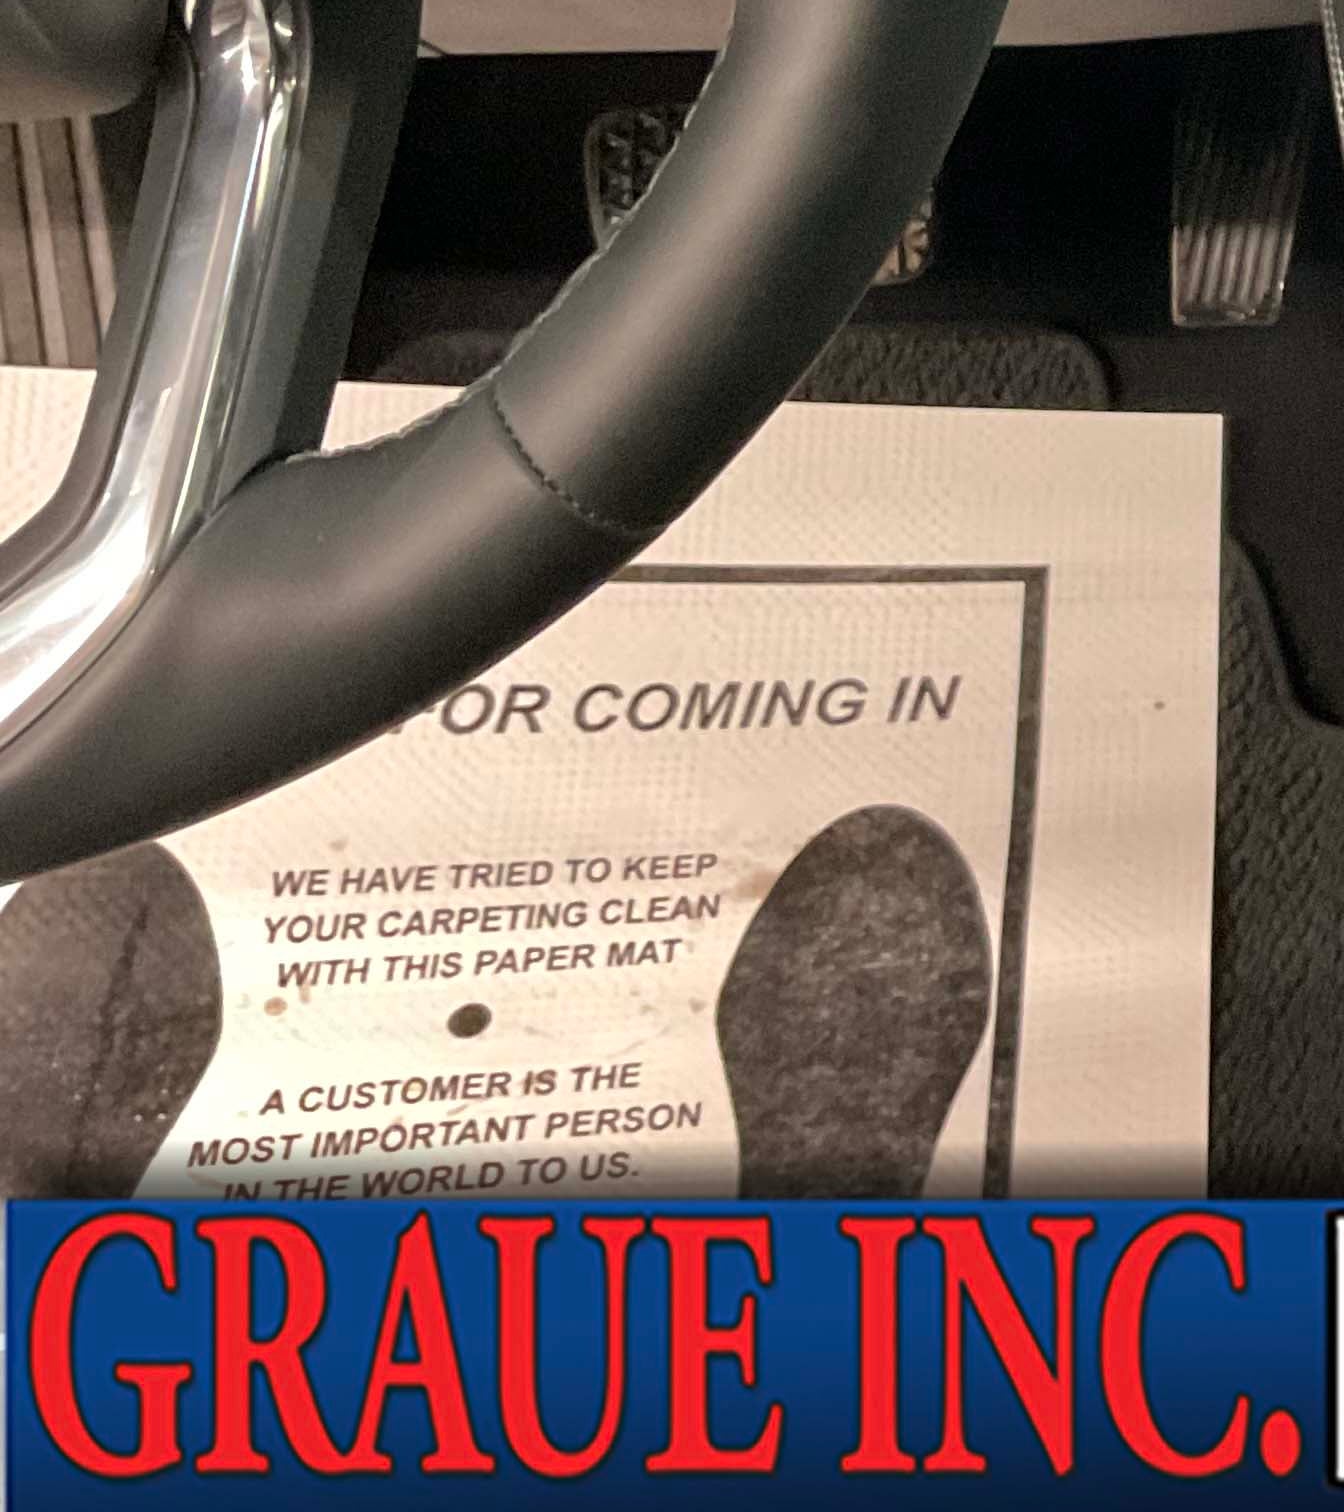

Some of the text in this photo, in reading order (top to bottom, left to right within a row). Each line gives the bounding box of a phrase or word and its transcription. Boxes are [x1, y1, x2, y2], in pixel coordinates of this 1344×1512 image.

[388, 674, 962, 735] OR COMING IN
[272, 852, 718, 897] WE HAVE TRIED TO KEEP
[263, 893, 721, 944] YOUR CARPETING CLEAN
[278, 938, 683, 988] WITH THIS PAPER MAT
[258, 1062, 642, 1116] A CUSTOMER IS THE
[187, 1102, 703, 1168] MOST IMPORTANT PERSON
[274, 1174, 351, 1200] THE
[363, 1160, 505, 1199] WORLD
[517, 1155, 567, 1186] TO
[580, 1151, 640, 1181] US.
